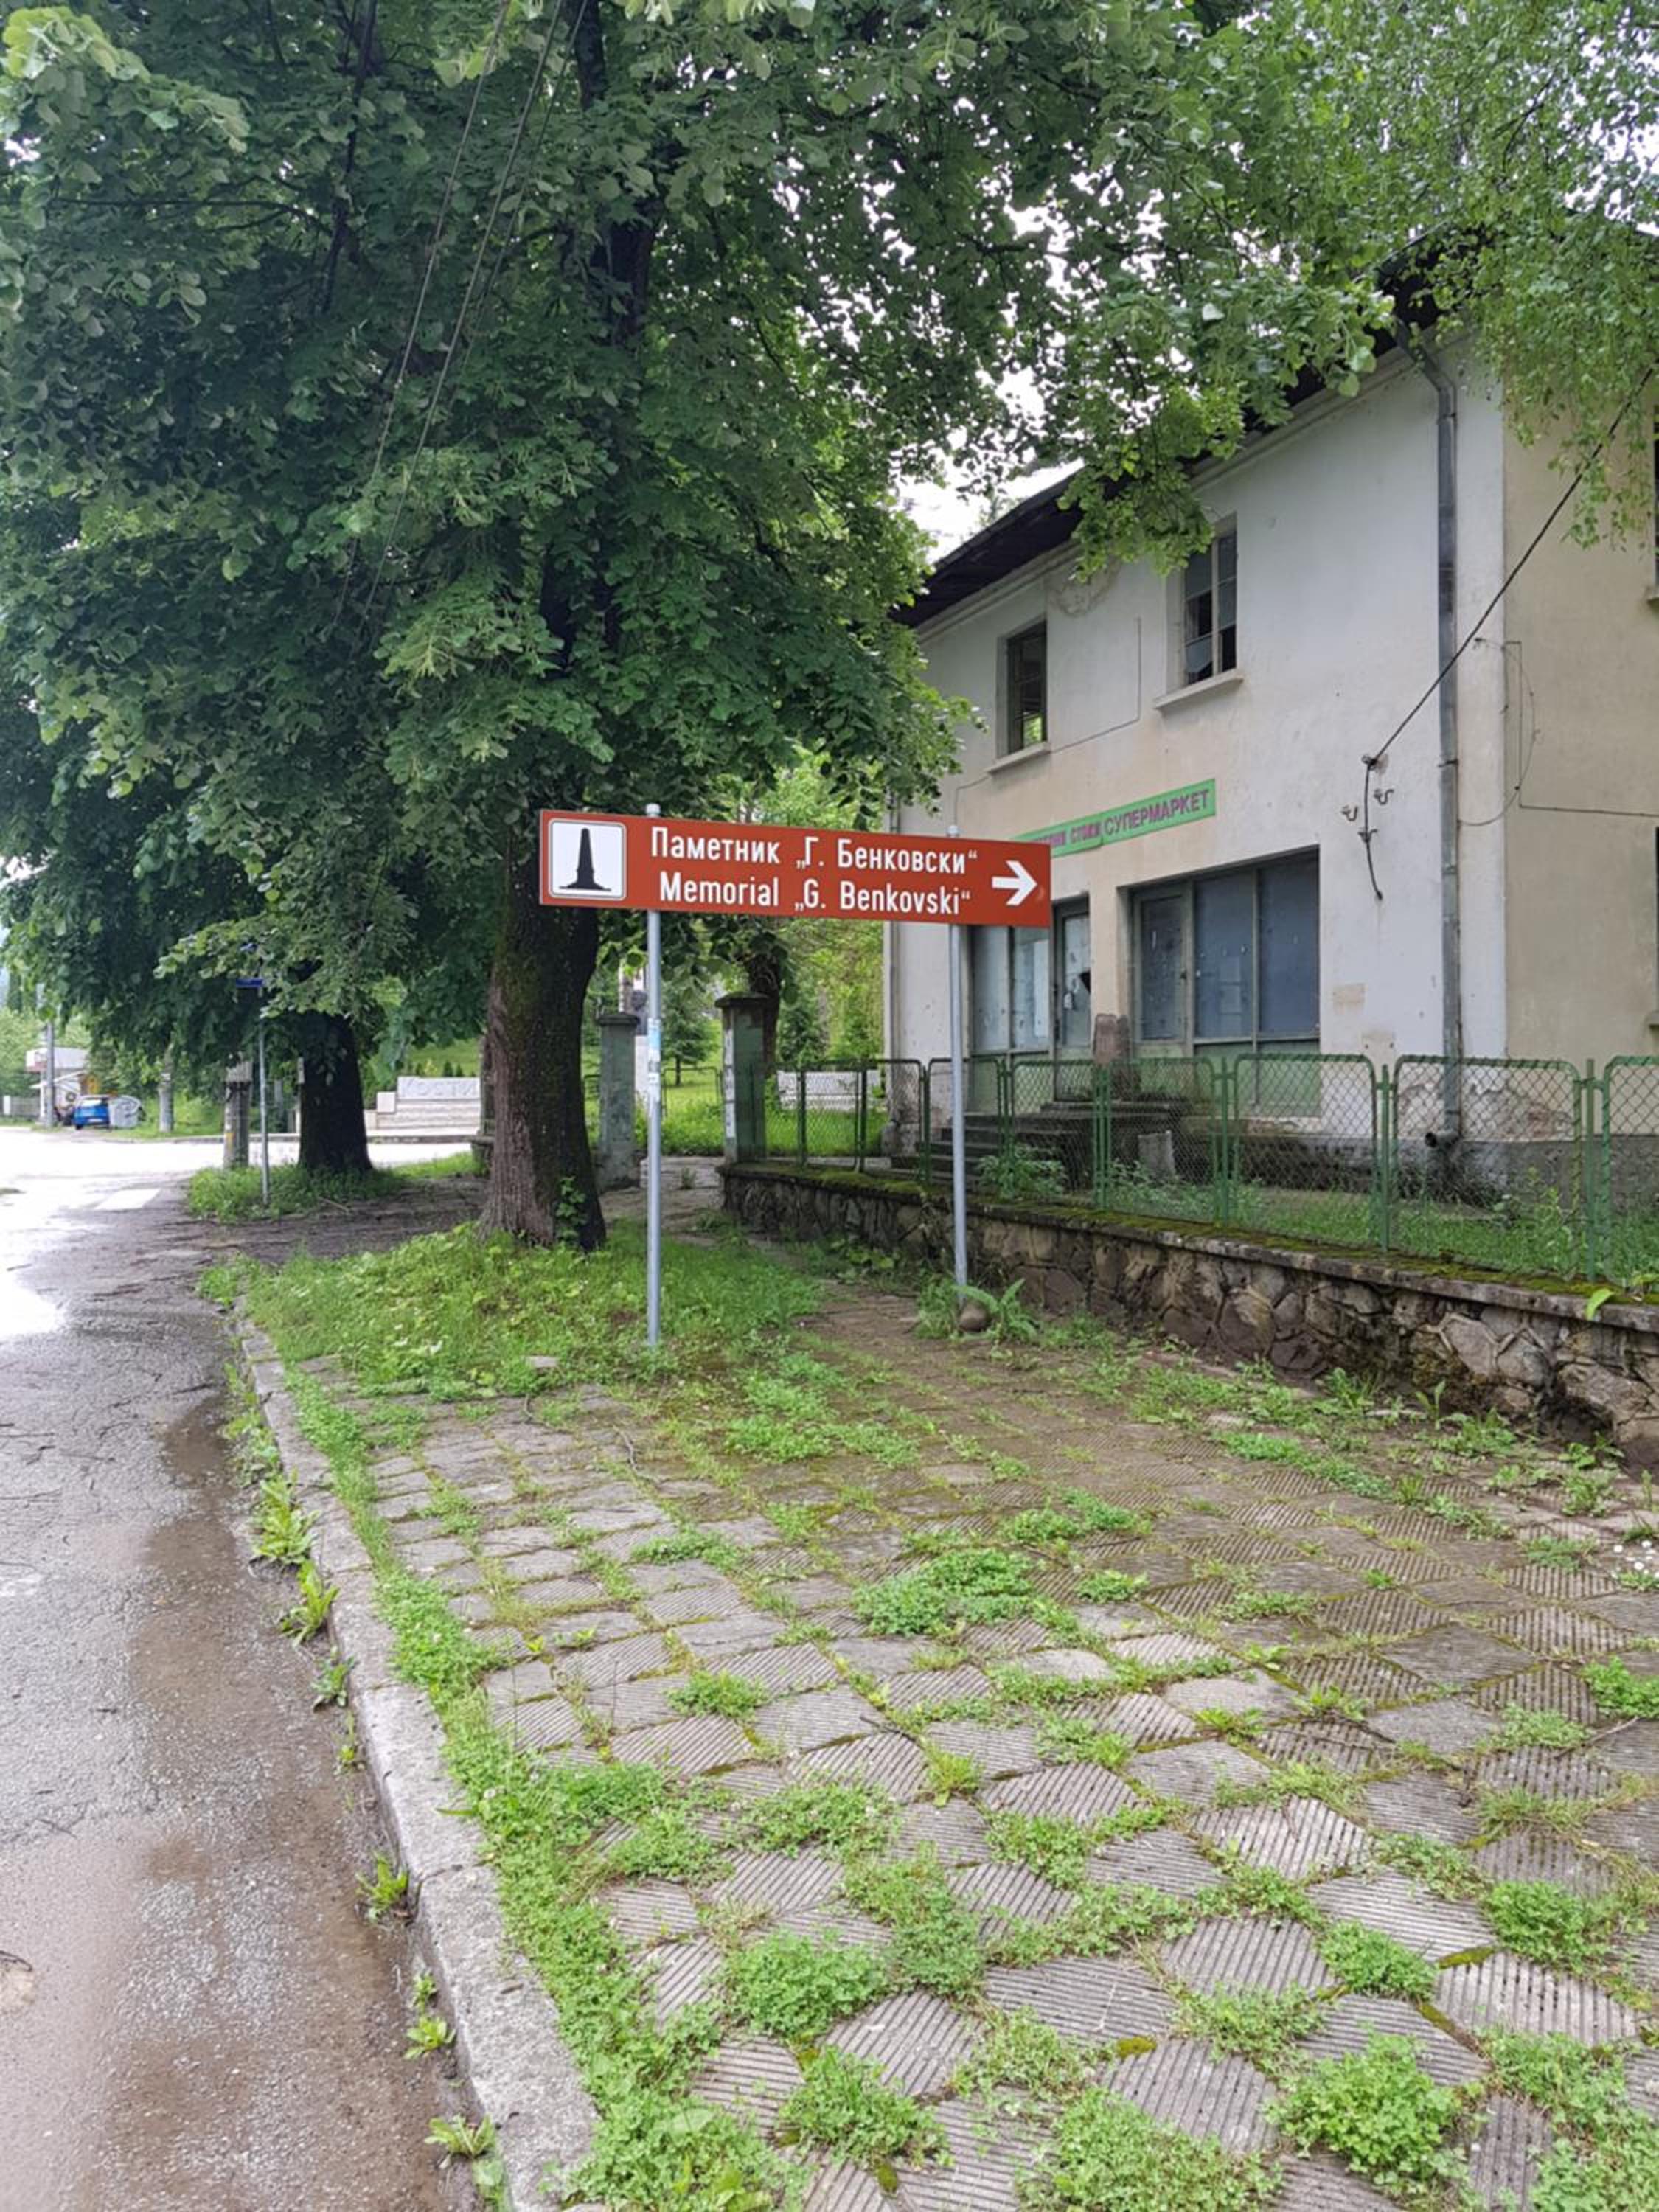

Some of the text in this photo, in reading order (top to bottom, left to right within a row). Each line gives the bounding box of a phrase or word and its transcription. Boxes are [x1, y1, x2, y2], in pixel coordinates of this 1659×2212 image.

[1105, 789, 1209, 835] СУПЕРМАРКЕТ
[652, 826, 780, 864] Паметник
[838, 838, 978, 874] Бенковски“
[660, 871, 779, 906] Memorial
[840, 880, 970, 914] Benkovski“
